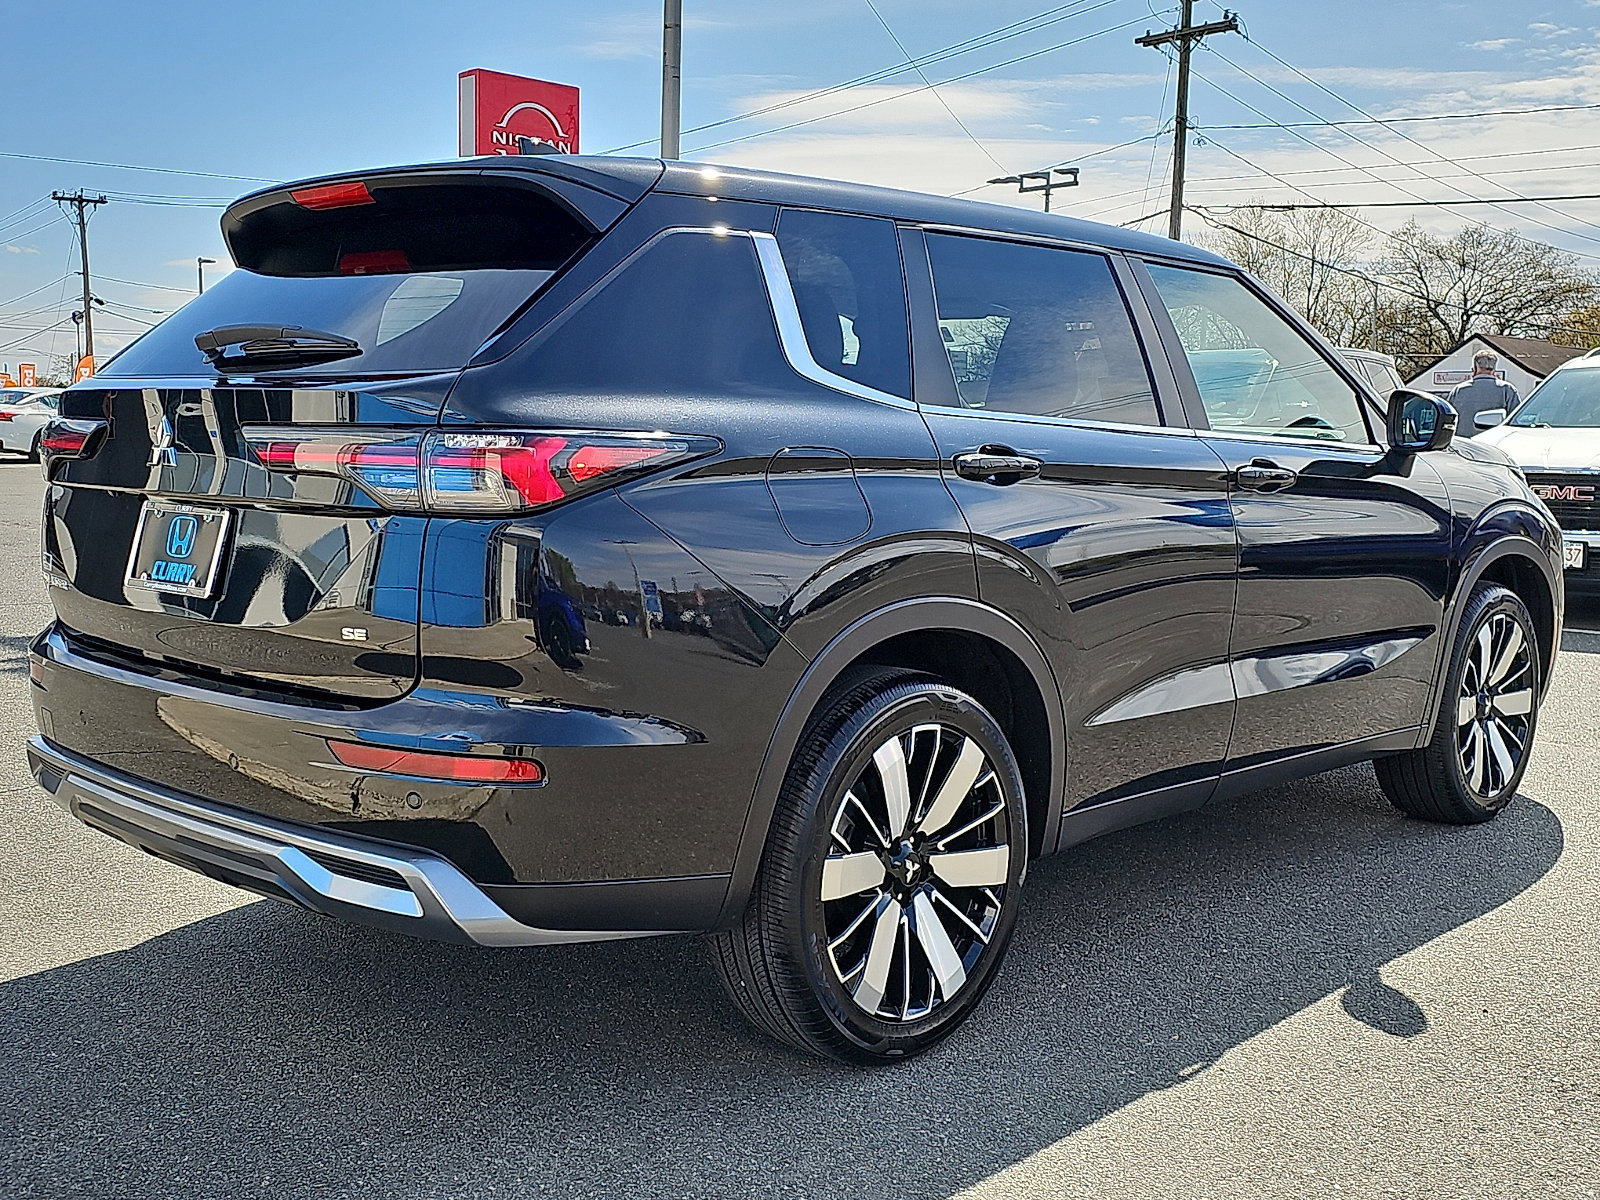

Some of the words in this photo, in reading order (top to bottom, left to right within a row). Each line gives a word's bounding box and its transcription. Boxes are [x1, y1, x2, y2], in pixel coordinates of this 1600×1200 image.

[1530, 485, 1595, 501] GMC
[1565, 547, 1582, 562] 37
[151, 560, 198, 584] CURRY
[341, 627, 367, 641] SE
